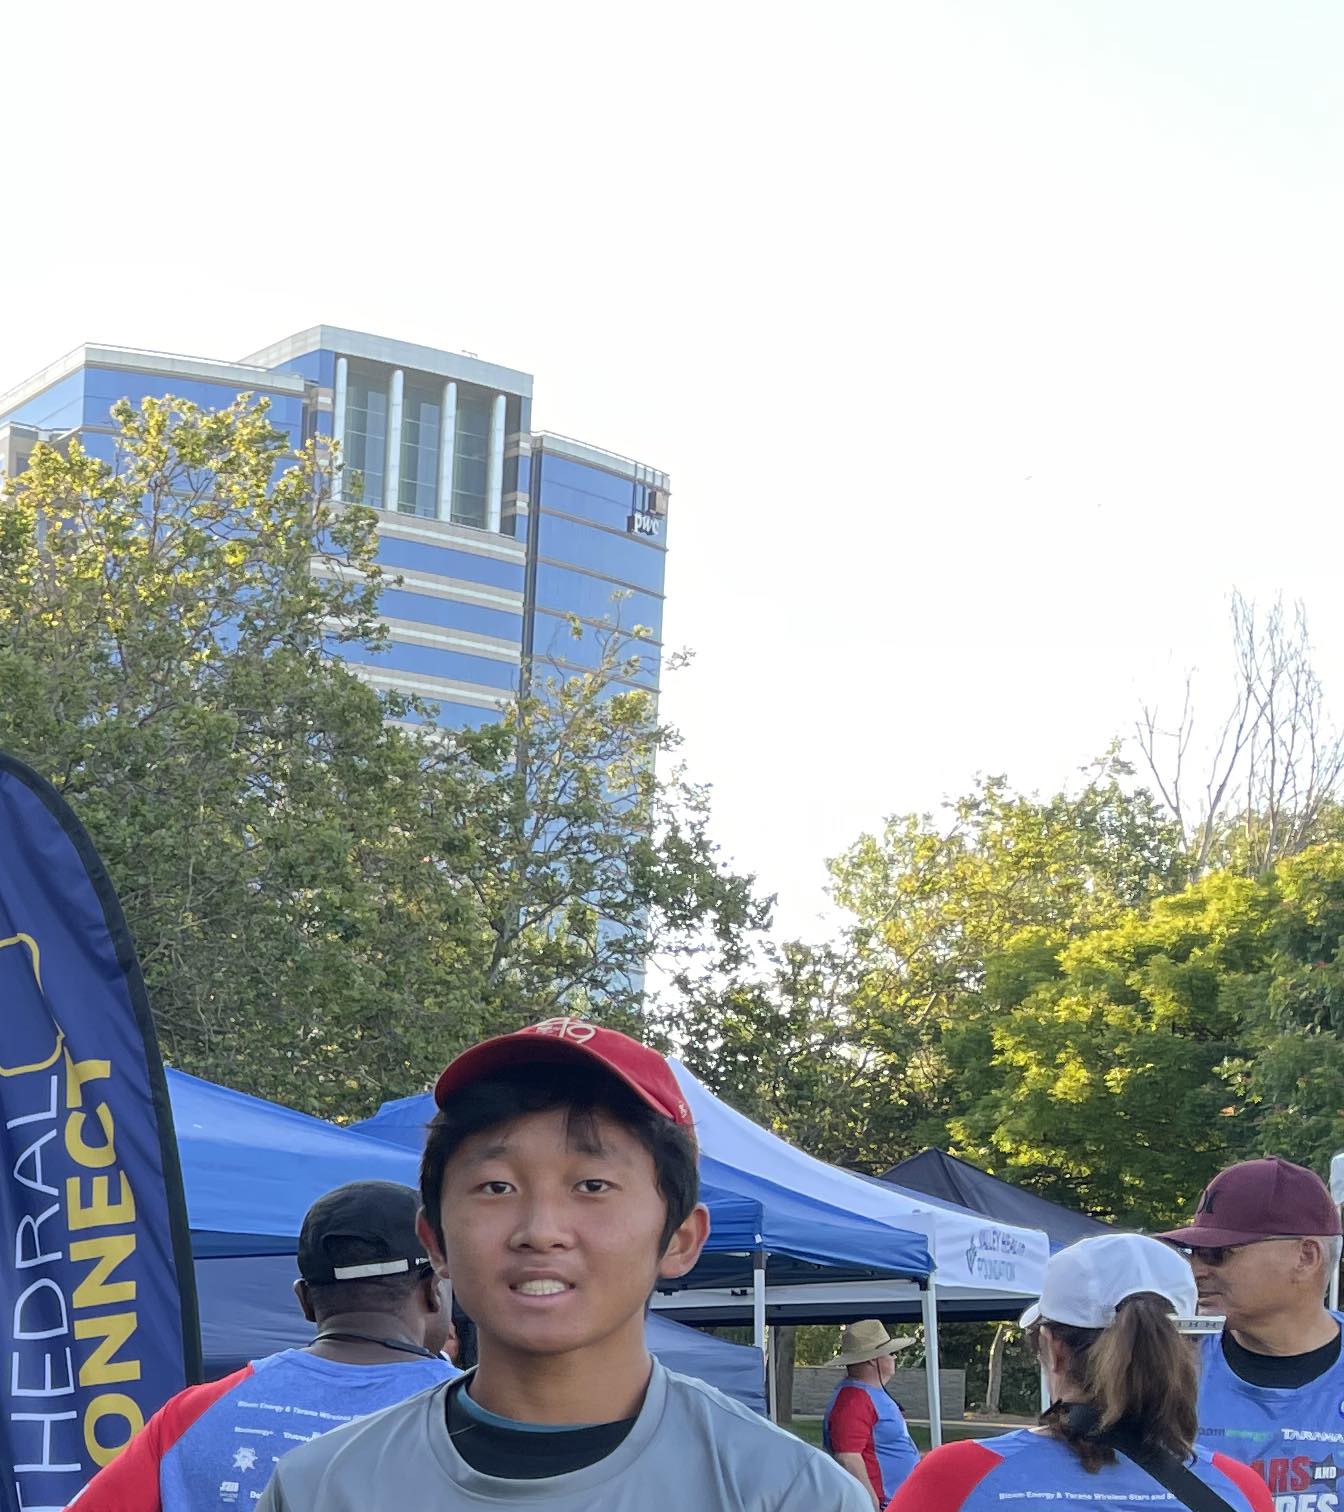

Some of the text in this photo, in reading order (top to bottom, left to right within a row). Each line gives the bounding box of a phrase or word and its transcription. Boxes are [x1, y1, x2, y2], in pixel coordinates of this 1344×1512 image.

[633, 512, 659, 535] pwc
[65, 1046, 145, 1468] ONNECT
[1315, 1466, 1336, 1479] AND
